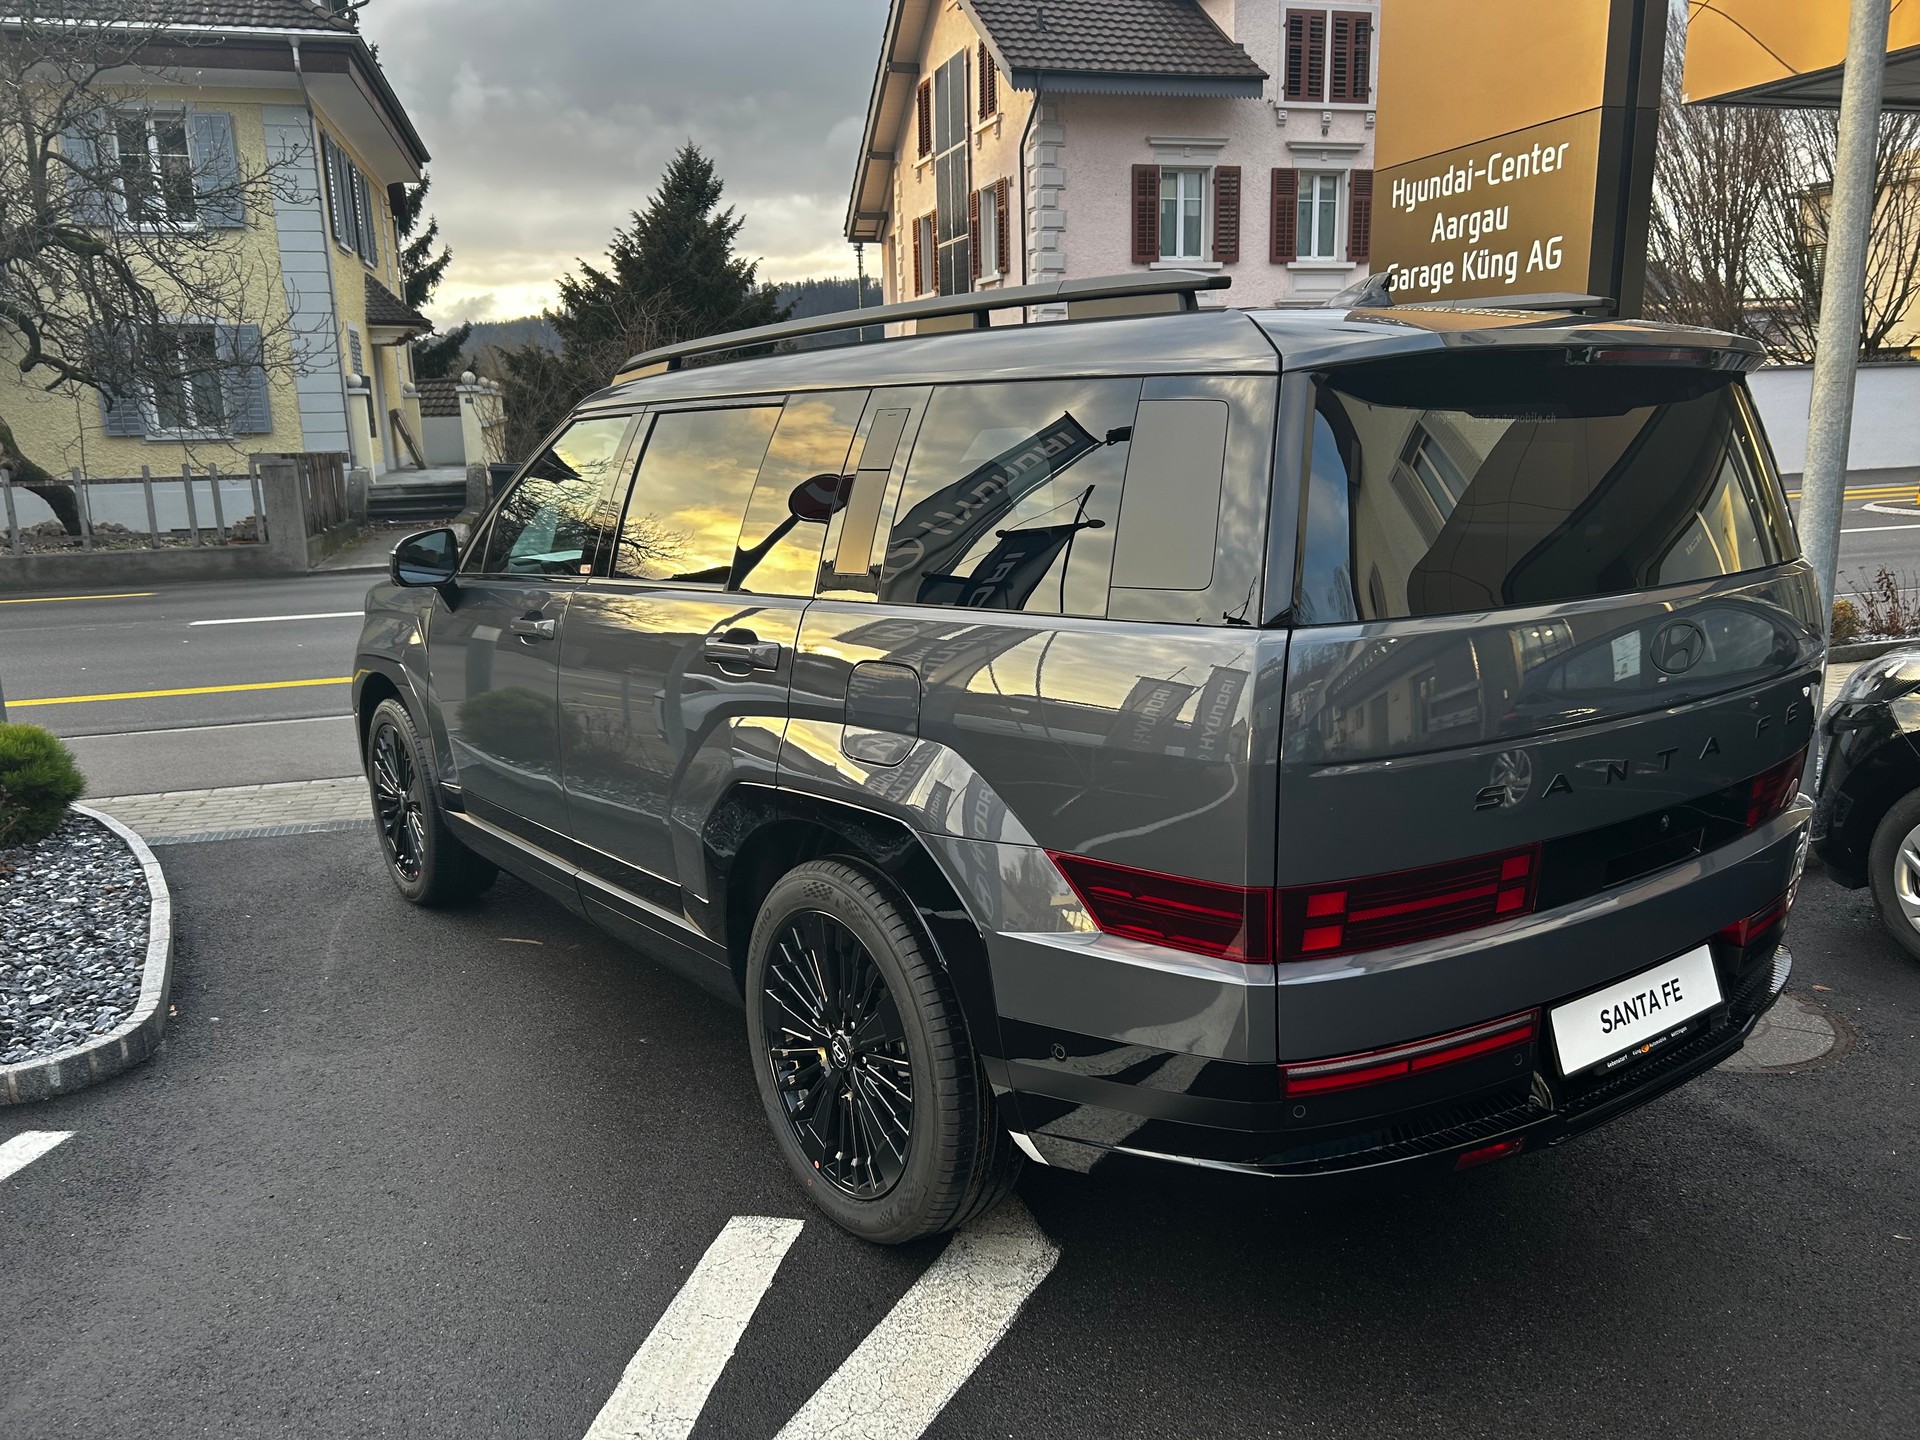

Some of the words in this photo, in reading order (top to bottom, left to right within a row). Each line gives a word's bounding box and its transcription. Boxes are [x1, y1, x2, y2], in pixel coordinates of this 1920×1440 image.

[1391, 142, 1569, 213] Hyundai-Center
[1430, 205, 1509, 244] Aargau
[1386, 260, 1455, 294] Garage
[1461, 248, 1519, 285] Küng
[1525, 235, 1563, 274] AG
[1199, 678, 1237, 750] HYUNDAI
[1472, 736, 1720, 811] SANTA
[1755, 701, 1799, 739] FE
[749, 907, 772, 967] KUMHO
[1600, 989, 1662, 1034] SANTA
[1661, 977, 1684, 1007] FE
